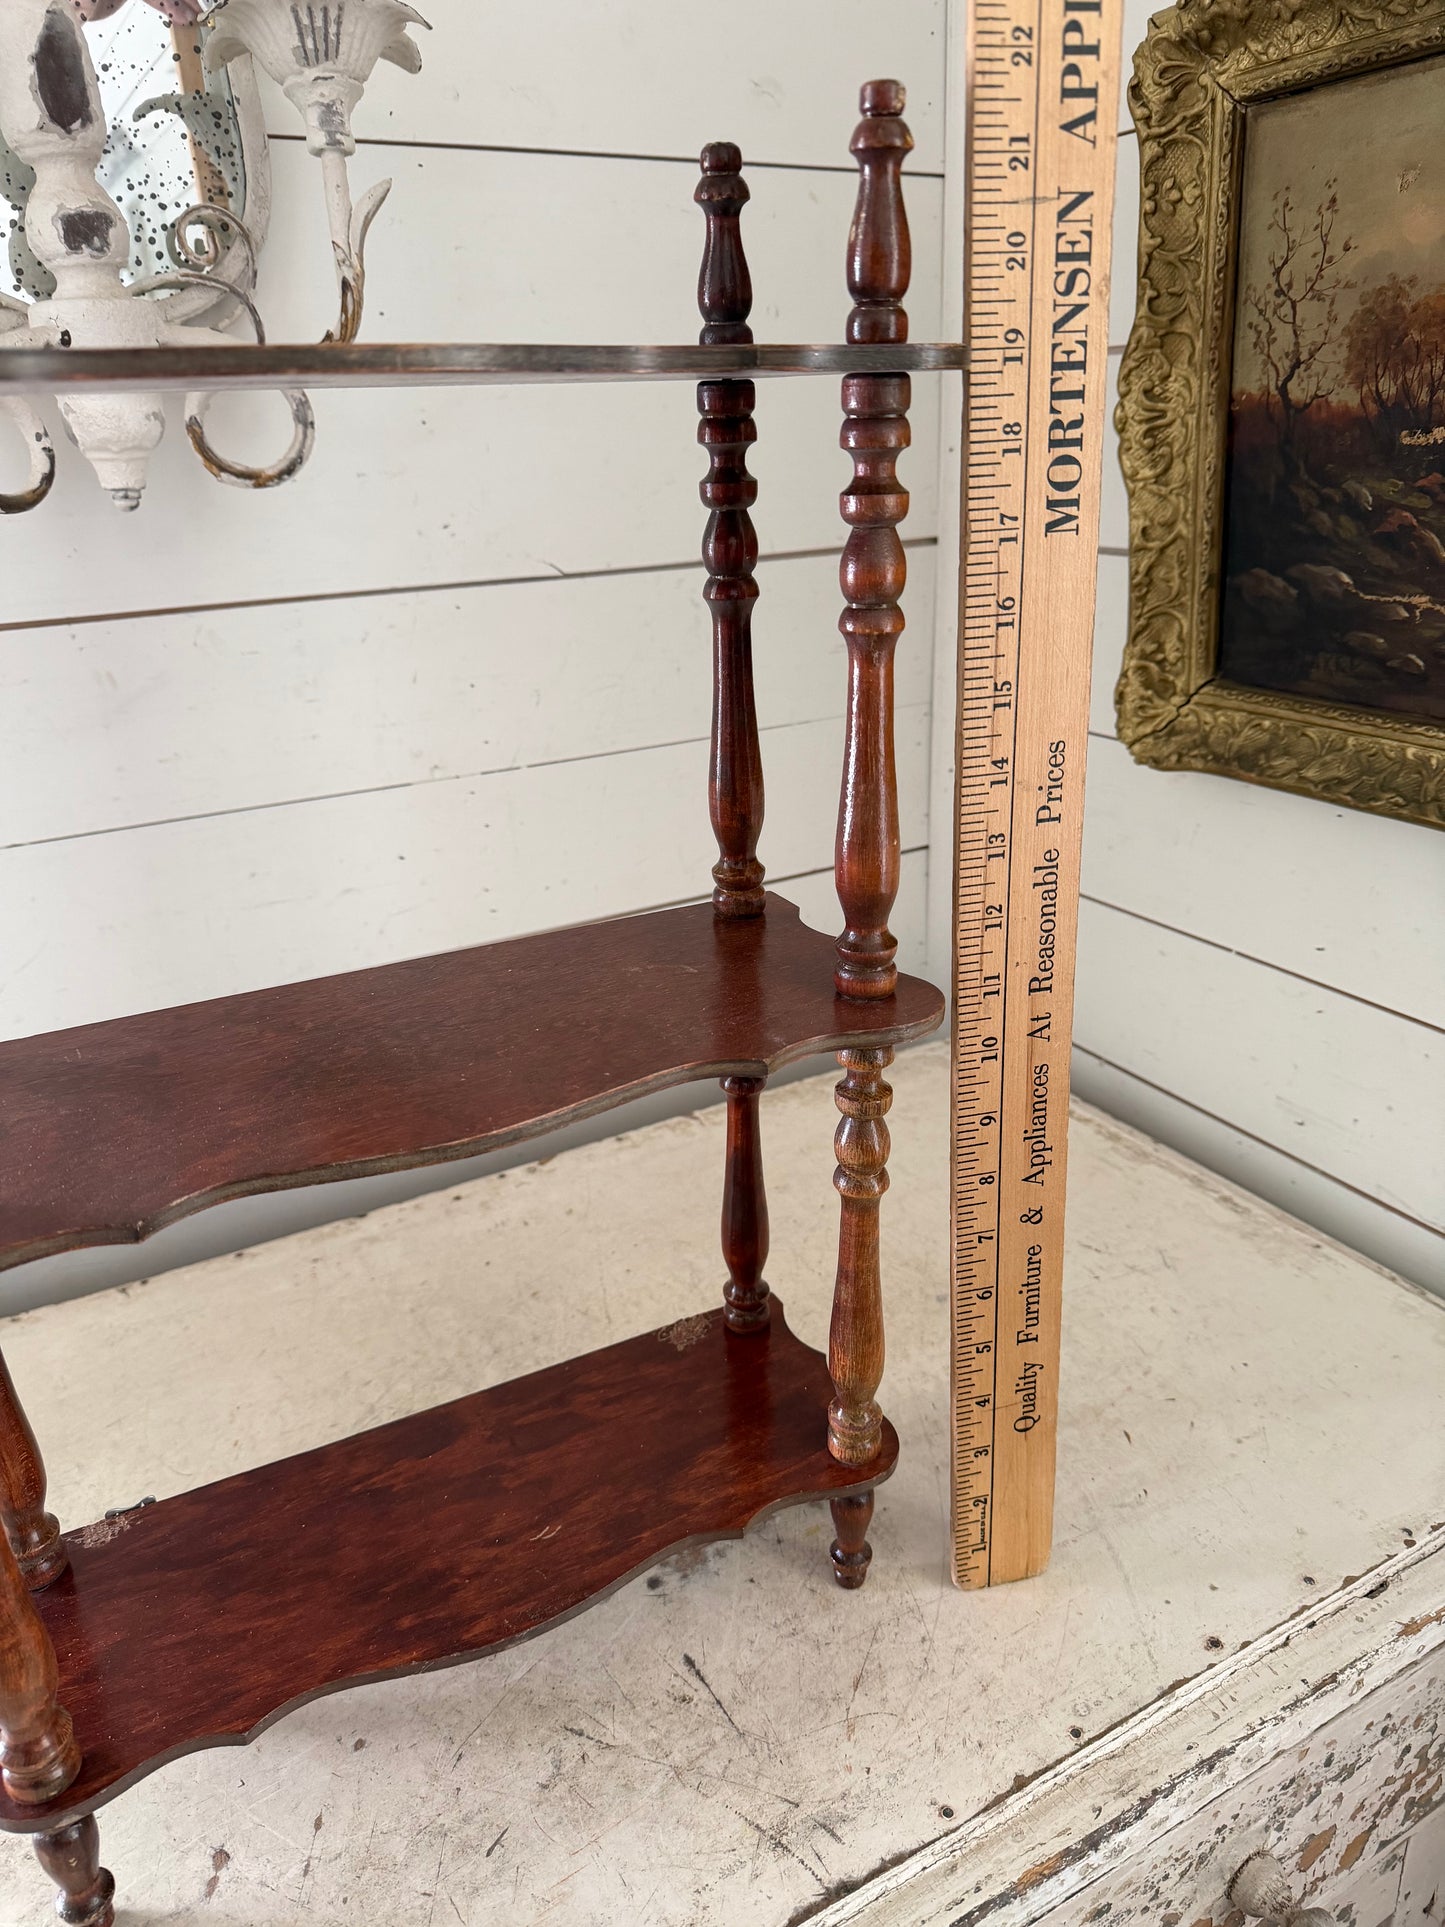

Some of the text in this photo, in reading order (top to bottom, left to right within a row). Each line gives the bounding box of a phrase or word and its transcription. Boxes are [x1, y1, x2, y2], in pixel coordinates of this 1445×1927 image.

[1011, 26, 1033, 67] 22
[1008, 133, 1030, 170] 21
[1006, 232, 1026, 271] 20
[1003, 328, 1024, 365] 19
[1045, 186, 1094, 537] MORTENSEN
[1002, 421, 1022, 456] 18
[999, 512, 1018, 545] 17
[996, 596, 1015, 630] 16
[993, 680, 1012, 710] 15
[990, 757, 1009, 788] 14
[988, 832, 1006, 861] 13
[985, 904, 1002, 931] 12
[983, 972, 1000, 999] 11
[980, 1036, 998, 1063] 10
[1014, 740, 1066, 1433] Quality Furniture & Appliances At Reasonable Prices
[979, 1115, 997, 1126] 9
[979, 1175, 995, 1185] 8
[977, 1234, 994, 1243] 7
[976, 1290, 993, 1300] 6
[976, 1344, 991, 1353] 5
[975, 1398, 990, 1408] 4
[974, 1449, 989, 1458] 3
[972, 1497, 988, 1507] 2
[971, 1544, 987, 1554] 1
